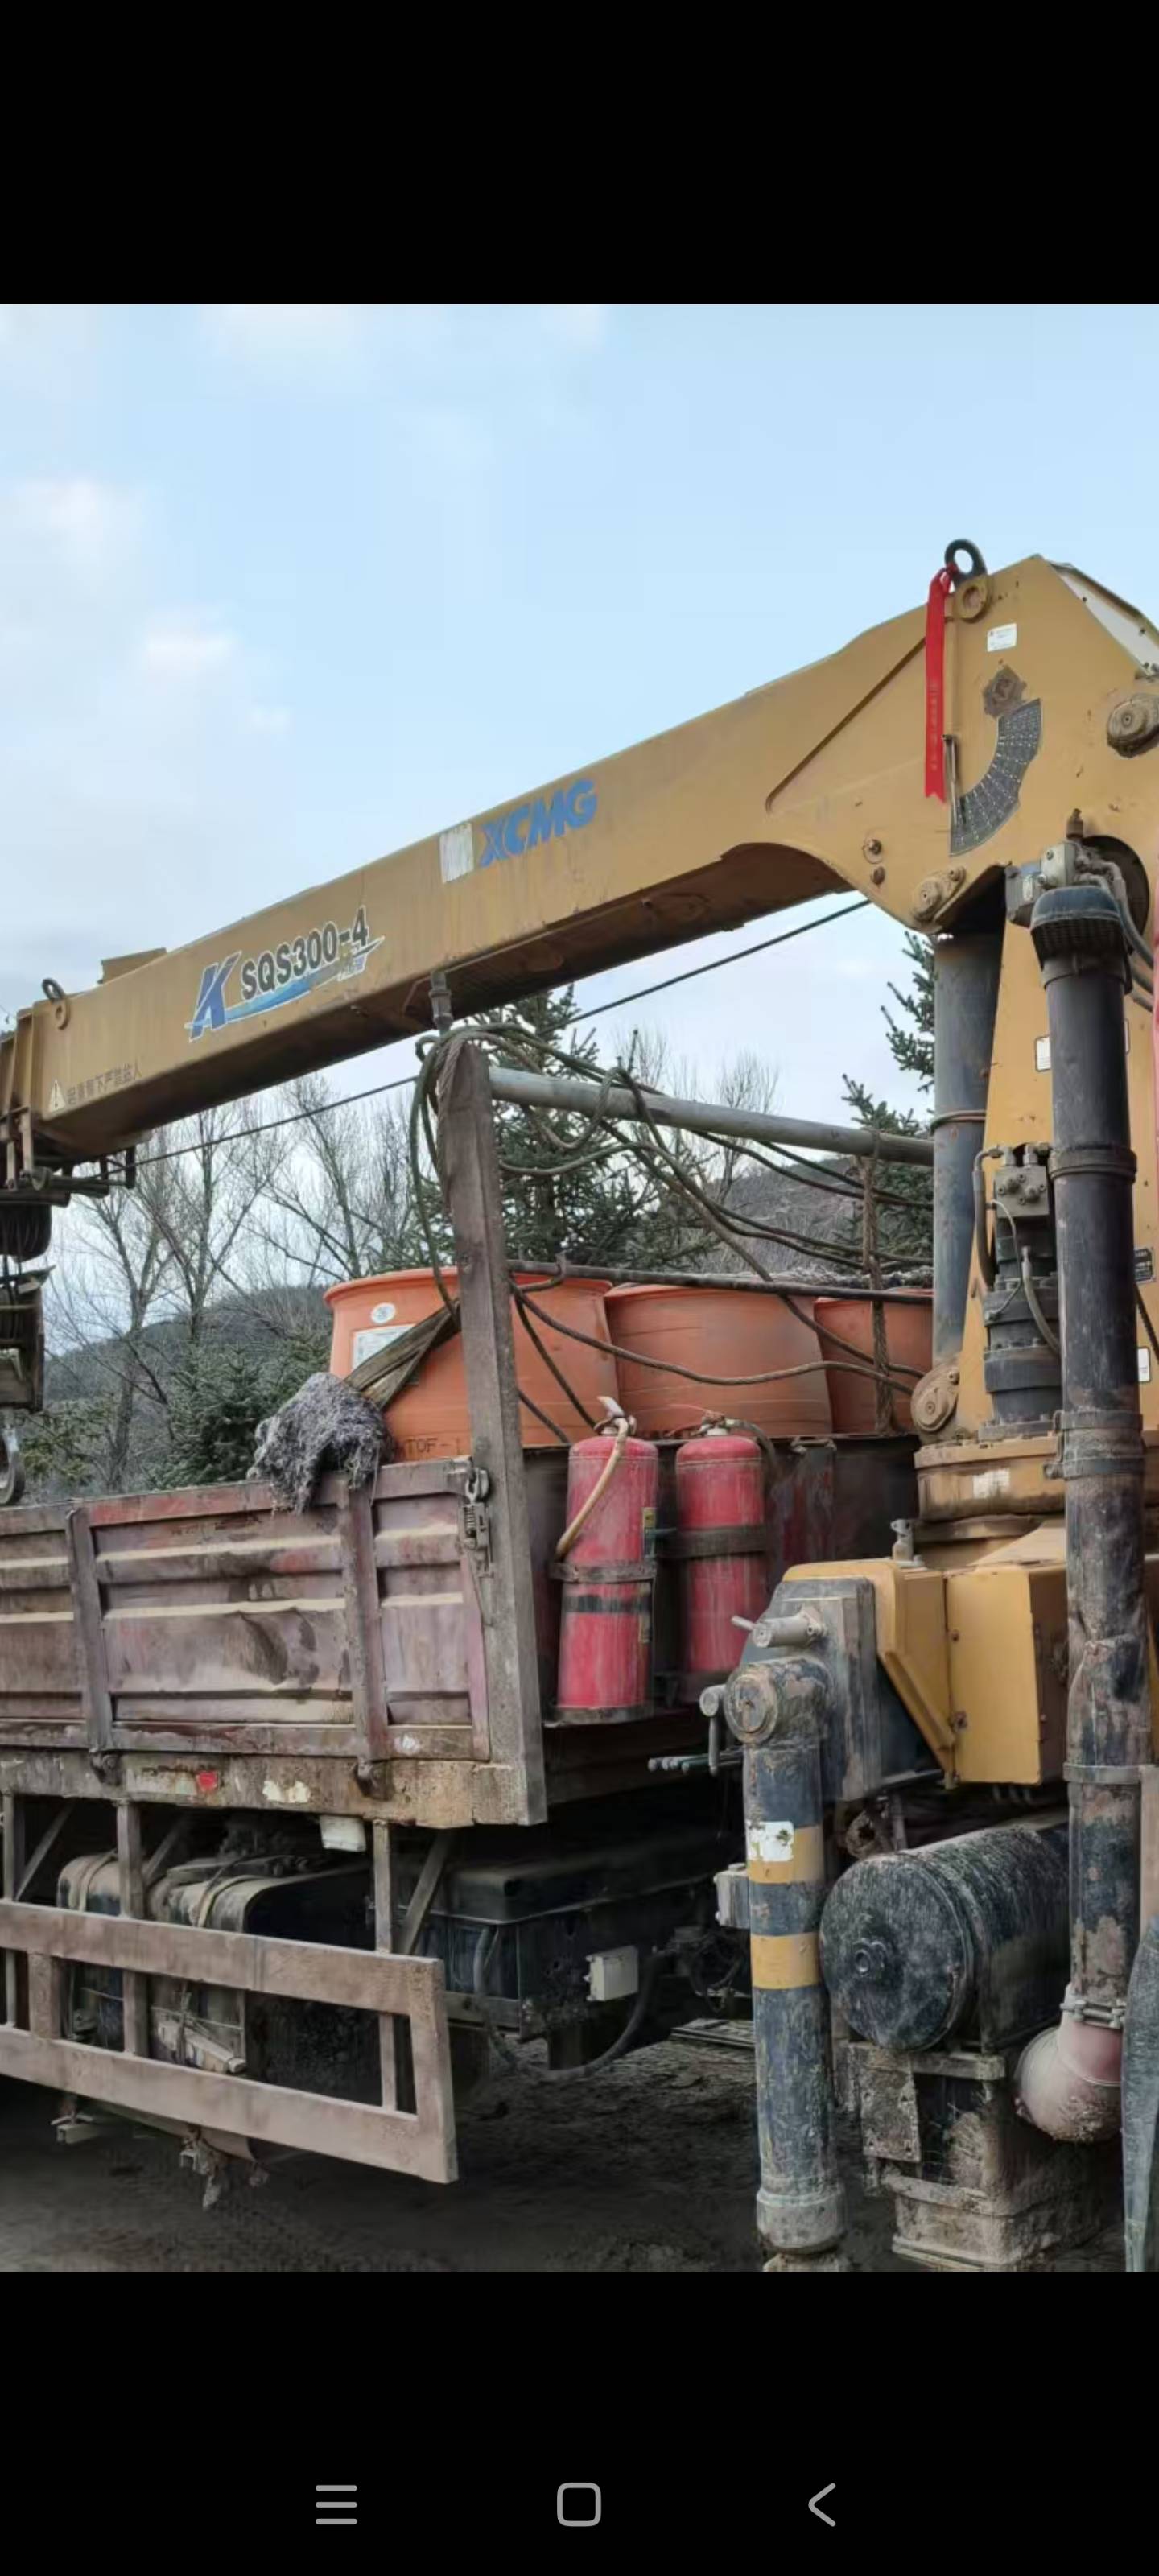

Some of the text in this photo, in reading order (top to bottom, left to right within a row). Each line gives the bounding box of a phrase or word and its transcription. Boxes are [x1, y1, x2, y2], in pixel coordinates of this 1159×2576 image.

[479, 778, 599, 868] XCMG
[189, 905, 369, 1042] K SQS300-4
